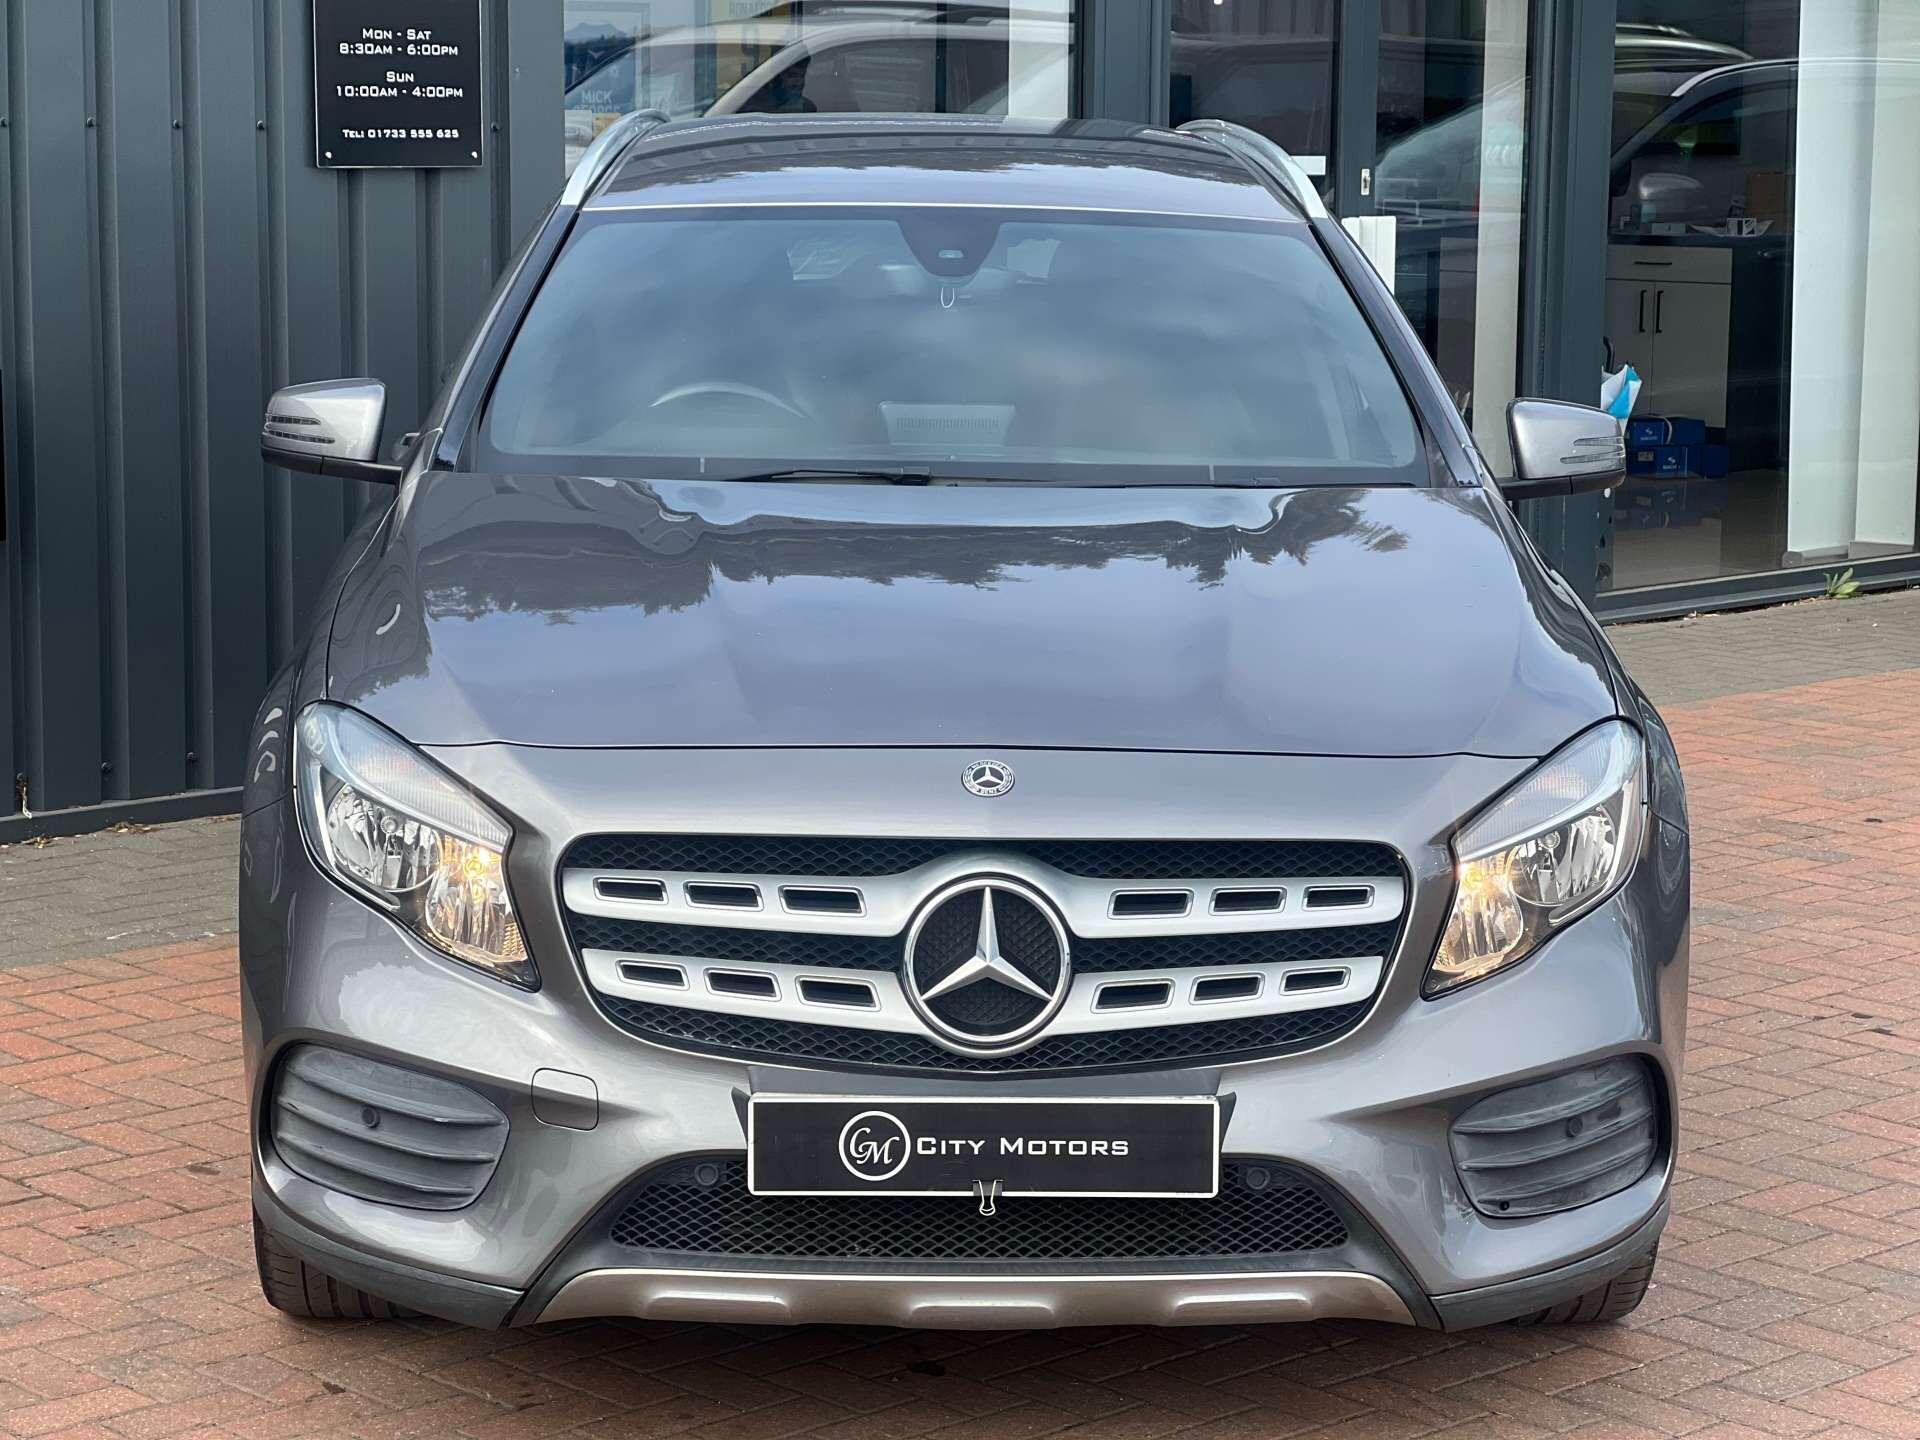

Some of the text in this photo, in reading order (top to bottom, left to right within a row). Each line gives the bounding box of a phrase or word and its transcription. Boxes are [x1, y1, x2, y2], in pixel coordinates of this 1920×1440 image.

[362, 28, 392, 40] MON
[407, 29, 431, 40] SAT
[340, 43, 393, 55] 8:30AM
[407, 44, 459, 56] 6:00PM
[386, 71, 415, 82] SUN
[336, 86, 398, 97] 10:00AM
[412, 86, 463, 98] 4:00PM
[367, 129, 406, 138] 01733
[410, 129, 433, 138] 555
[436, 129, 459, 138] 625
[916, 1137, 1129, 1156] CITY MOTORS
